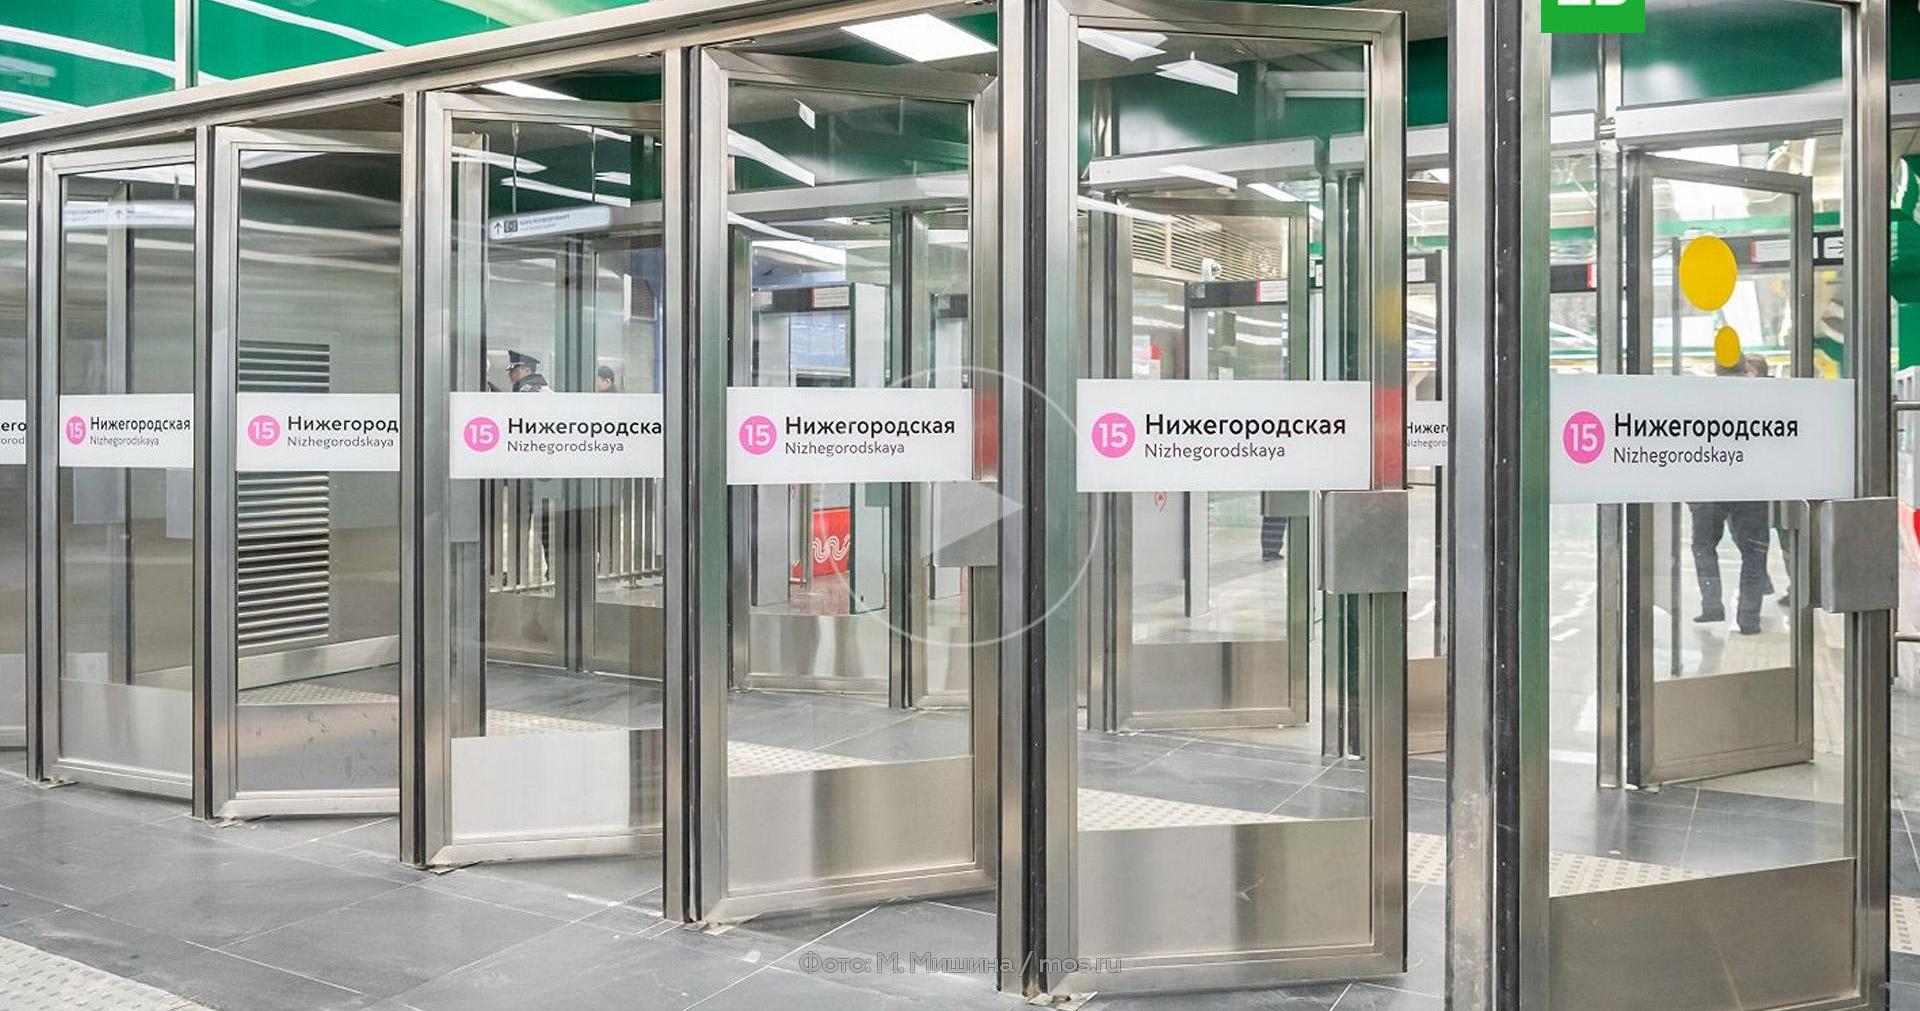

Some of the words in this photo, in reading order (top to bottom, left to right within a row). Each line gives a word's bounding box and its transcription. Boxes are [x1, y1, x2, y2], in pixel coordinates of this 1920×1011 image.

[68, 422, 84, 438] 15
[90, 416, 191, 433] Нижегородская
[253, 421, 275, 440] 15
[288, 416, 399, 434] Нижегород
[508, 418, 662, 437] Нижегородска
[785, 416, 955, 438] Нижегородская
[1145, 413, 1346, 439] Нижегородская
[1614, 413, 1798, 442] Нижегородская
[89, 436, 160, 447] Nizhegorodskaya
[287, 436, 394, 450] Nizhegorodskaya
[469, 424, 494, 445] 15
[745, 424, 770, 447] 15
[1099, 423, 1128, 448] 15
[1570, 423, 1598, 452] 15
[507, 440, 624, 455] Nizhegorodskaya
[784, 441, 905, 457] Nizhegorodskaya
[1144, 443, 1286, 461] Nizhegorodskaya
[1613, 447, 1743, 467] Nizhegorodskaya
